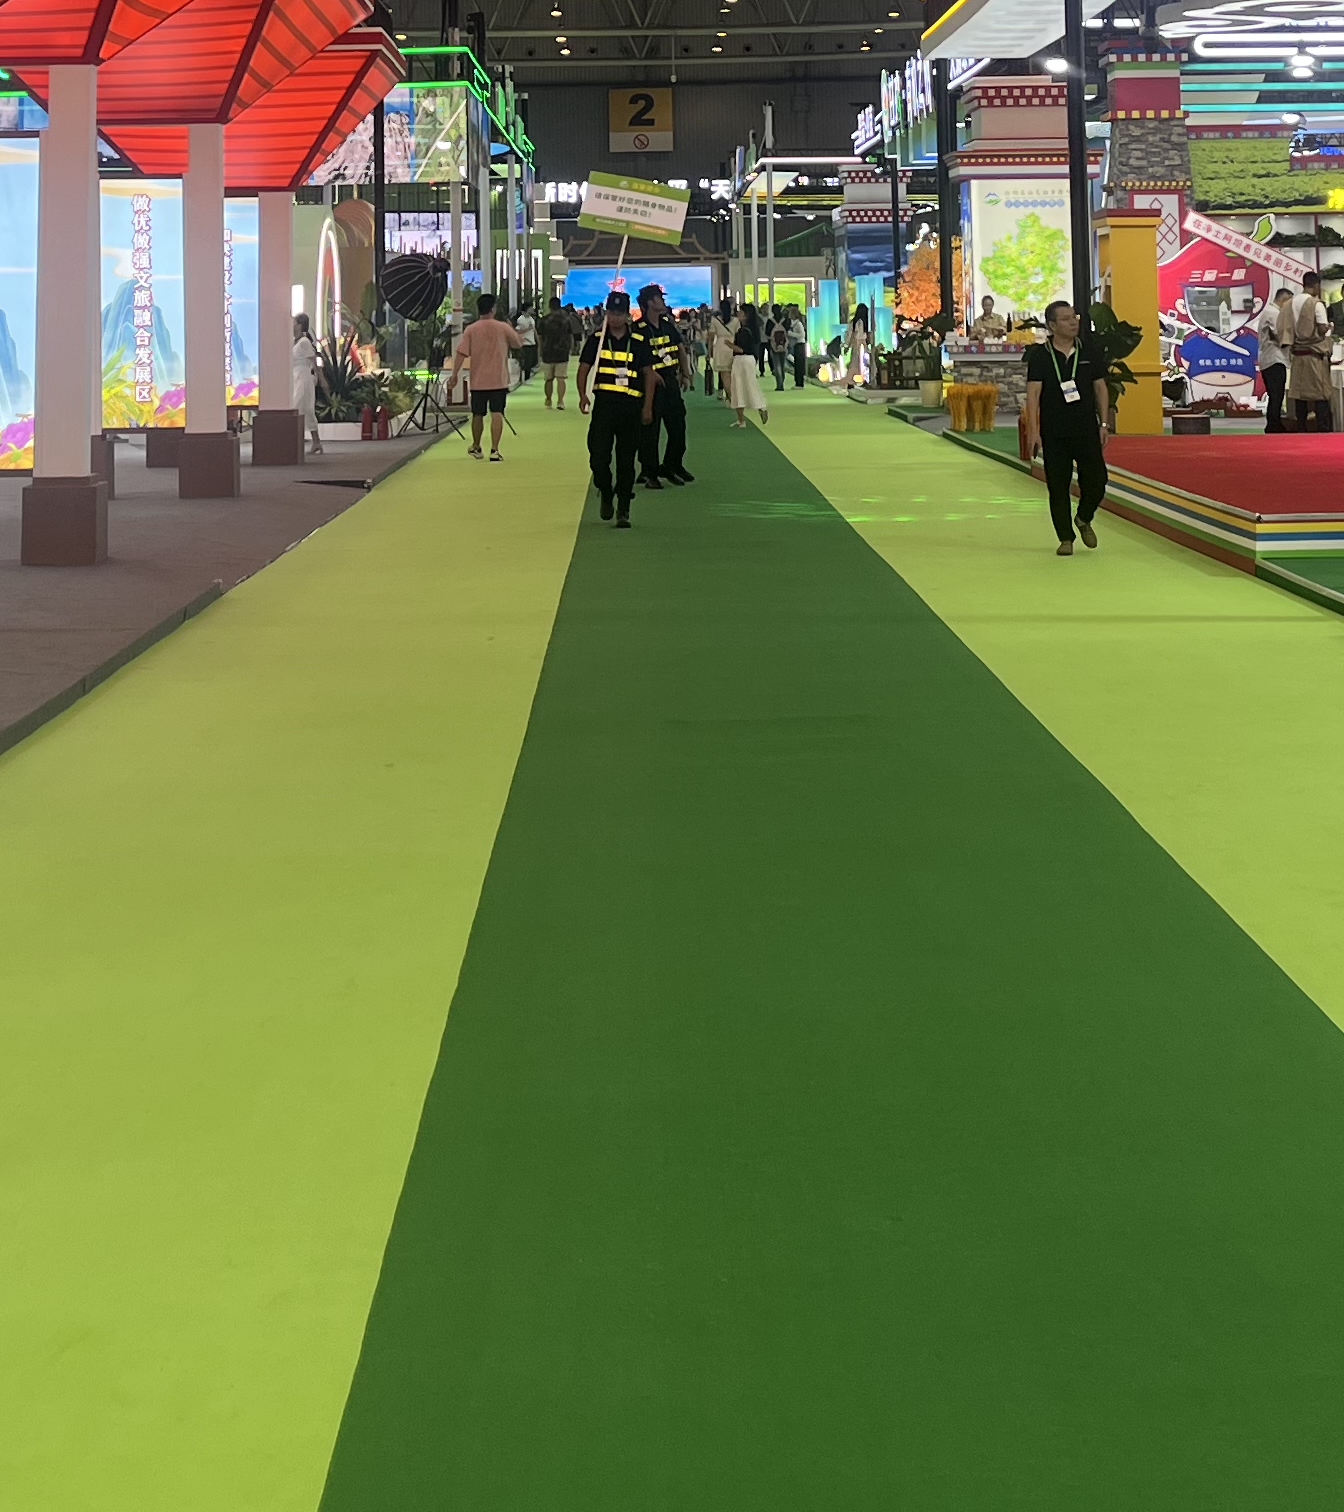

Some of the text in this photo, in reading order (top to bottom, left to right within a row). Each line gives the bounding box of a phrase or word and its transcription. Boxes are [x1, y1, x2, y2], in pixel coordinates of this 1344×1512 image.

[628, 92, 656, 127] 2
[131, 193, 154, 404] 做优做强文旅融合发展区
